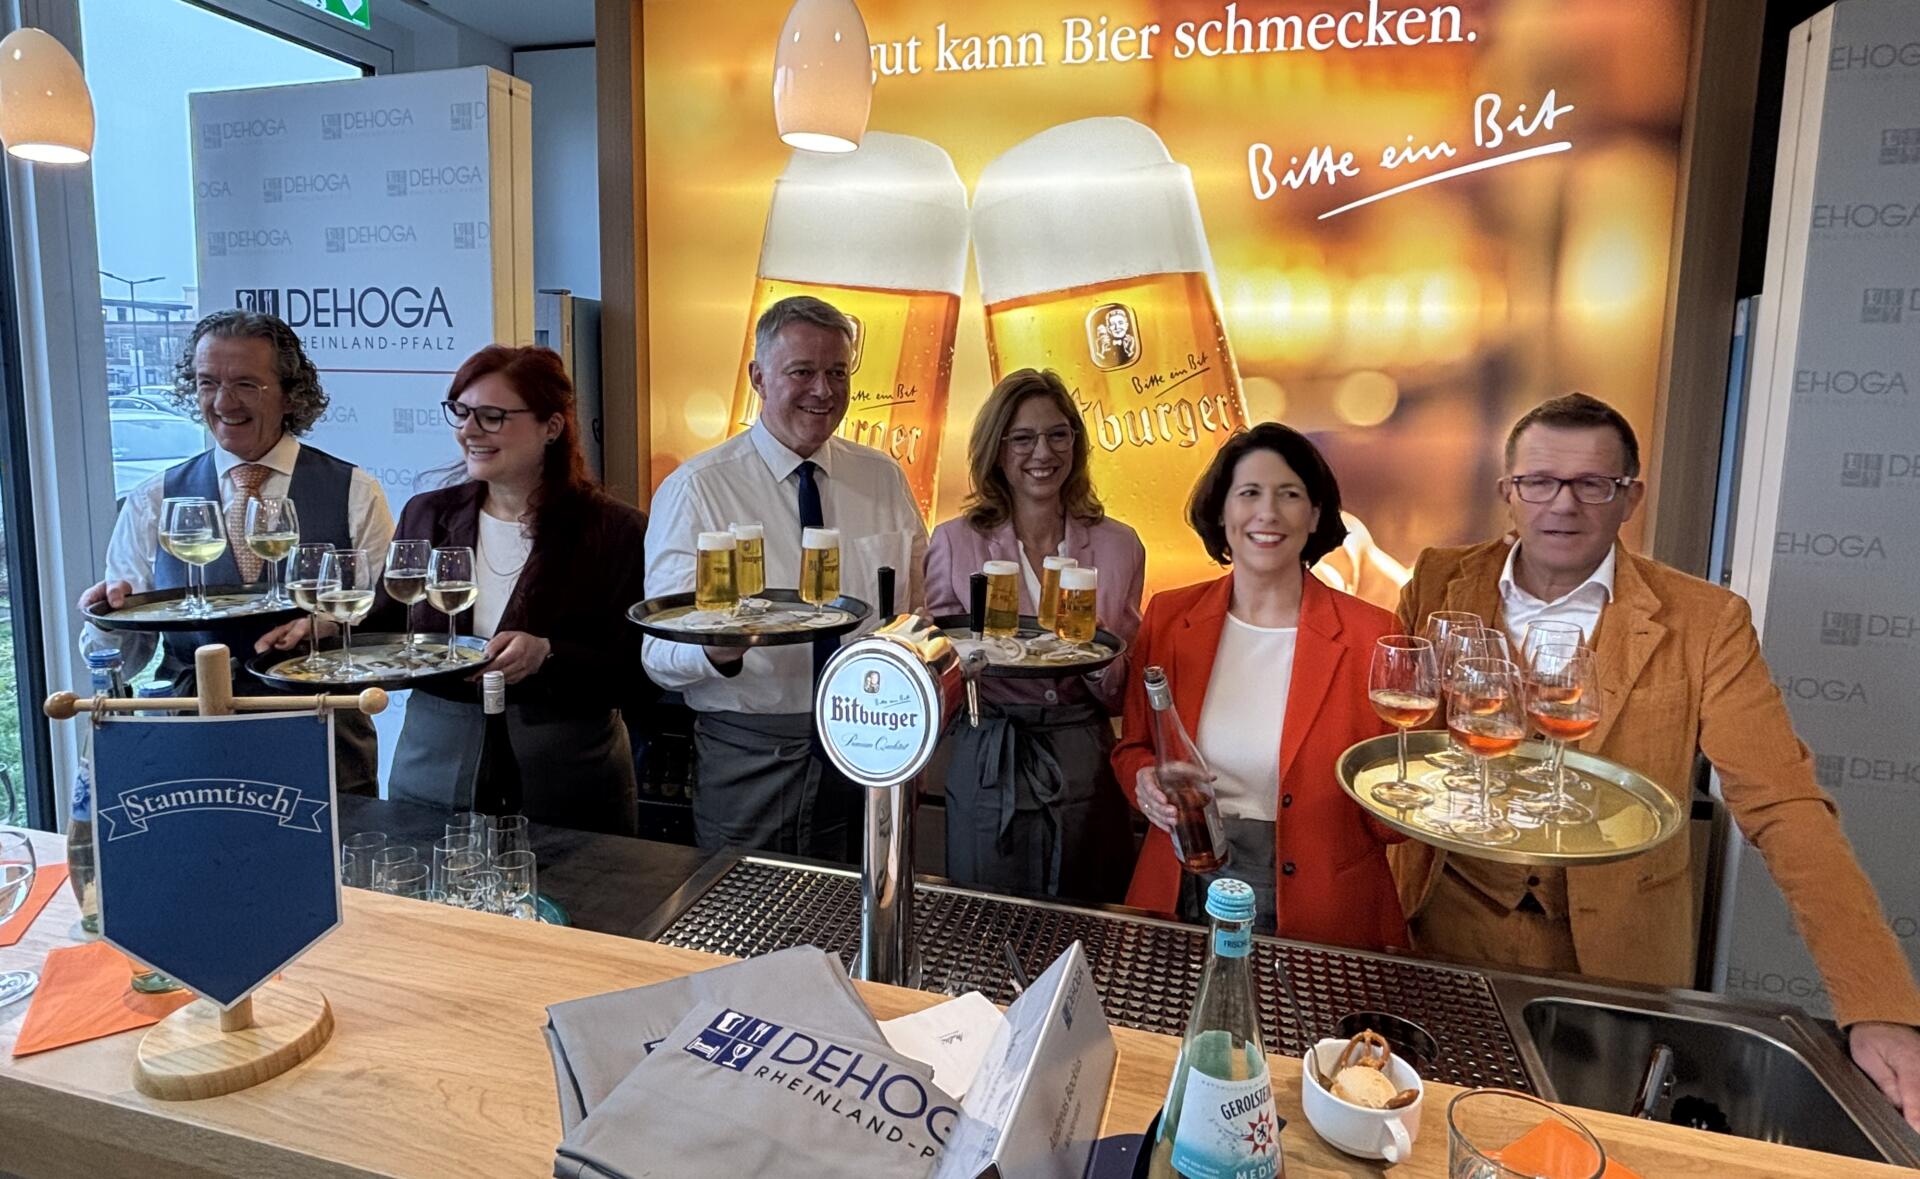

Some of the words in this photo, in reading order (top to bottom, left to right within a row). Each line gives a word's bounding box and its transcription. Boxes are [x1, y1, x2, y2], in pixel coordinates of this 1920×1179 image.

[934, 23, 1046, 72] kann
[1061, 16, 1161, 65] Bier
[1174, 0, 1477, 59] schmecken.
[1830, 42, 1920, 71] EHOG
[222, 119, 288, 139] DEHOGA
[344, 107, 414, 130] DEHOGA
[1248, 143, 1360, 200] Bitte
[1380, 135, 1456, 168] ein
[1474, 89, 1574, 148] Bit
[198, 181, 232, 198] OGA
[284, 174, 350, 193] DEHOGA
[409, 166, 483, 187] DEHOGA
[1813, 203, 1920, 229] EHOGA
[228, 229, 292, 248] DEHOGA
[347, 224, 418, 244] DEHOGA
[287, 286, 454, 329] DEHOGA
[300, 335, 455, 351] HEINLAND-PFALZ
[1131, 374, 1165, 395] Bitte
[1187, 352, 1209, 370] Bit
[1795, 368, 1909, 396] EHOGA
[850, 390, 871, 401] itte
[1071, 387, 1231, 453] tburger
[1775, 531, 1887, 560] EHOGA
[830, 695, 918, 731] Bitburger
[125, 782, 291, 820] Stammtisch
[771, 1031, 959, 1147] DEHOG
[753, 1065, 937, 1159] RHEINLAND-P
[1236, 1156, 1278, 1179] MEDIU
